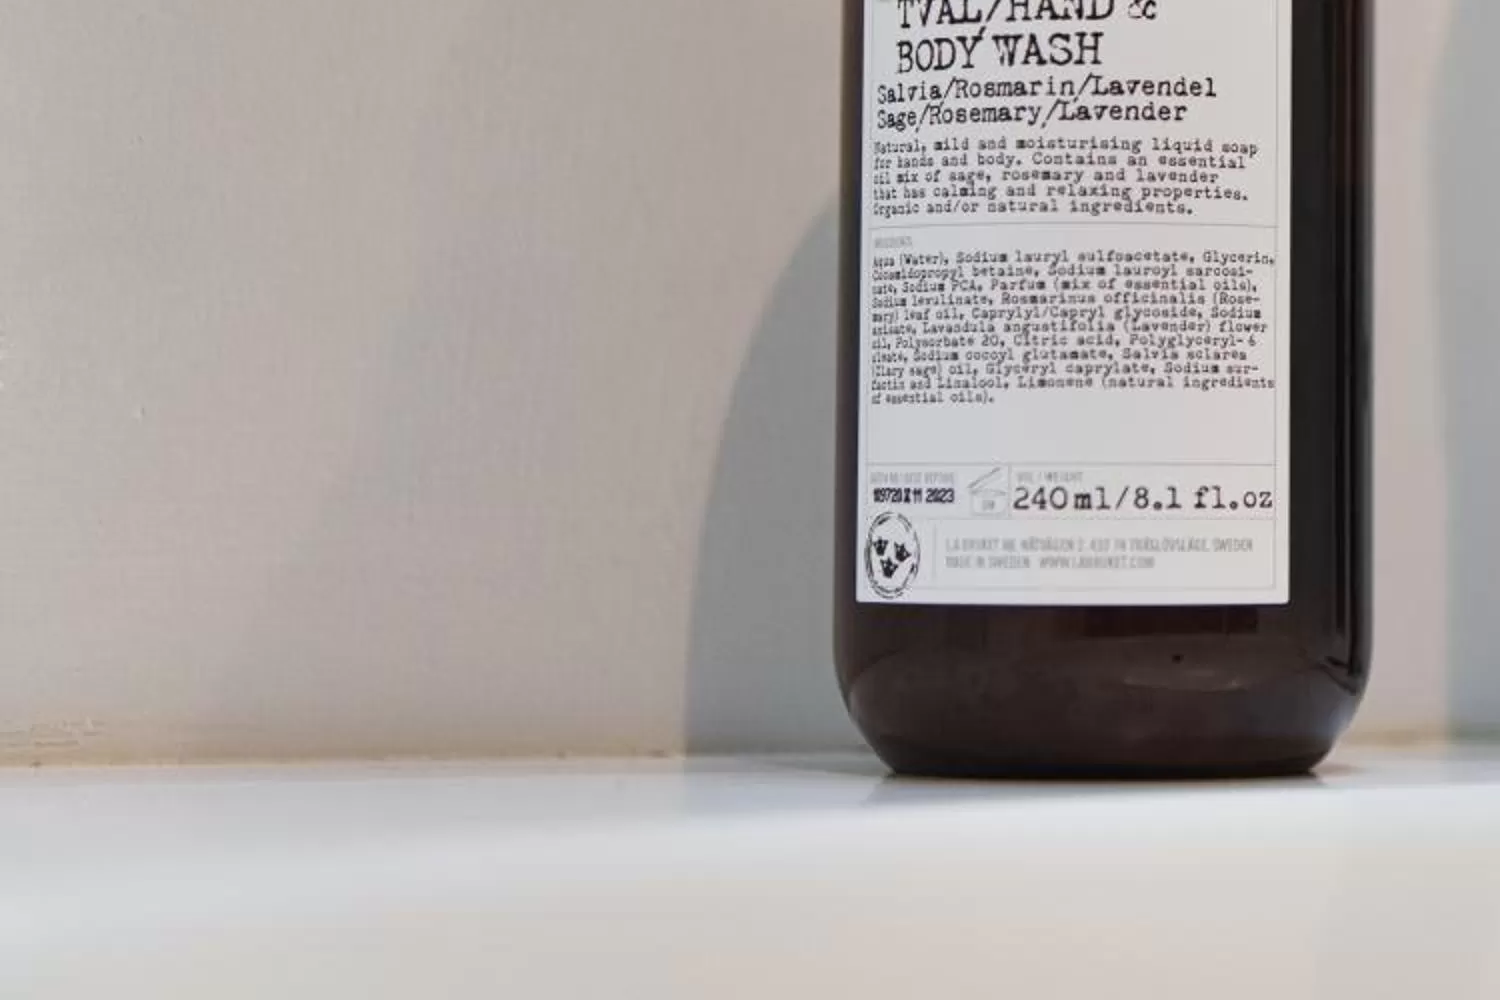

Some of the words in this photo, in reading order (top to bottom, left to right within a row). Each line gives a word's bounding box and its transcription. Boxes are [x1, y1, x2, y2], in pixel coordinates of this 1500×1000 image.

[898, 34, 983, 73] BODY
[994, 31, 1103, 67] WASH
[878, 73, 1217, 103] Salvia/Rosmarin/Lavendel
[878, 98, 1188, 132] Sage/Rosemary/Lavender
[934, 137, 969, 150] mild
[979, 137, 1007, 149] and
[1016, 137, 1143, 152] moisturising
[1152, 138, 1213, 153] liquid
[1222, 143, 1259, 158] soap
[874, 156, 892, 169] for
[898, 154, 934, 168] hands
[942, 153, 968, 166] and
[978, 152, 1022, 168] body.
[1032, 152, 1117, 165] Contains
[1127, 156, 1147, 165] an
[1159, 154, 1246, 169] essential
[897, 171, 918, 182] mix
[925, 170, 941, 182] of
[949, 171, 991, 184] sage,
[1003, 171, 1083, 183] rosemary
[1094, 169, 1125, 181] and
[1136, 169, 1218, 183] lavender
[904, 186, 926, 198] has
[934, 184, 997, 200] calming
[1006, 184, 1036, 196] and
[1047, 183, 1131, 199] relaxing
[1142, 185, 1248, 200] properties.
[927, 200, 979, 214] and/or
[988, 200, 1059, 213] natural
[1070, 200, 1193, 216] ingredients.
[956, 251, 1008, 263] Sodium
[1015, 250, 1068, 266] lauryl
[1048, 264, 1105, 275] Sodium
[1114, 265, 1177, 278] lauroyl
[991, 278, 1046, 290] Parfum
[1098, 279, 1117, 289] of
[1125, 279, 1206, 290] essential
[1104, 292, 1205, 304] officinalis
[1211, 307, 1262, 319] Sodium
[1014, 333, 1067, 346] Citric
[1122, 348, 1179, 360] Salvia
[986, 362, 1056, 376] Glyceryl
[1164, 363, 1219, 374] Sodium
[910, 378, 930, 389] and
[1184, 377, 1275, 391] ingredients
[1193, 485, 1273, 511] fl.oz
